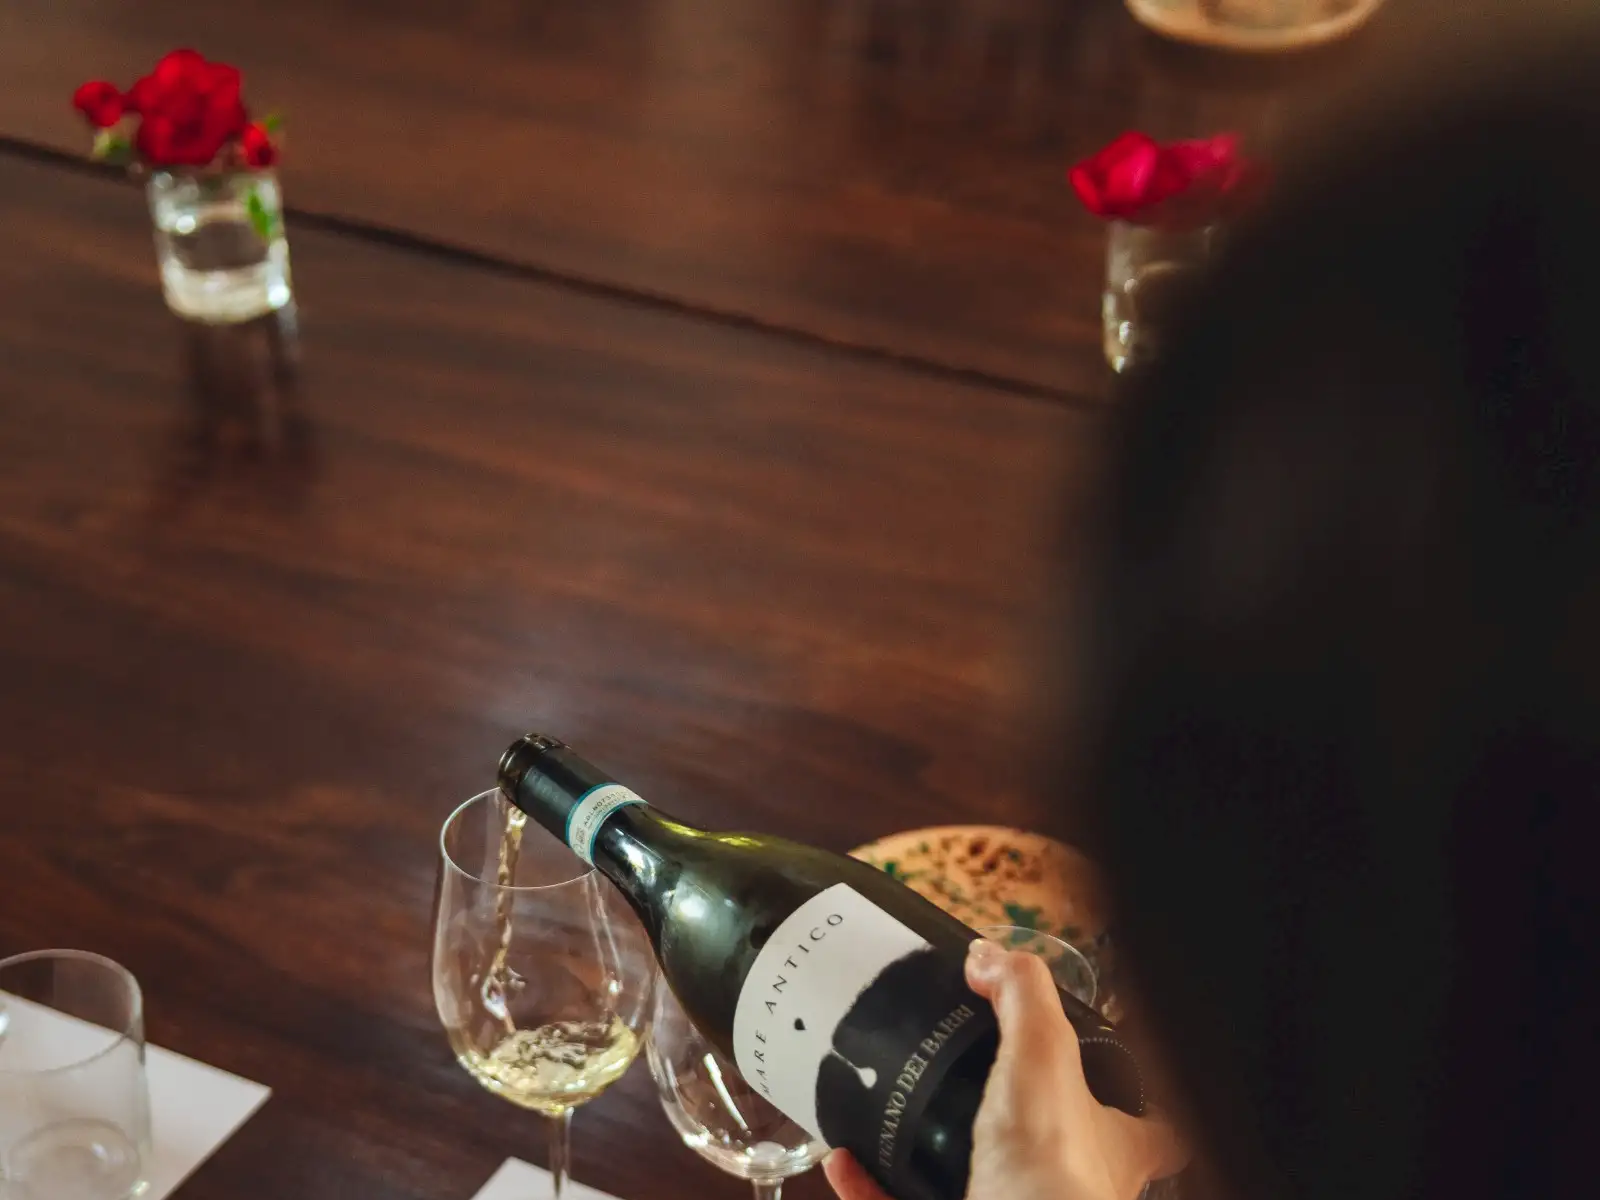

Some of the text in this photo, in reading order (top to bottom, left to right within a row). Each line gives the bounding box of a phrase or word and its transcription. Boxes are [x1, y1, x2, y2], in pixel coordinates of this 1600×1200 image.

[753, 913, 843, 1099] MARE ANTICO
[896, 1052, 929, 1092] DEI
